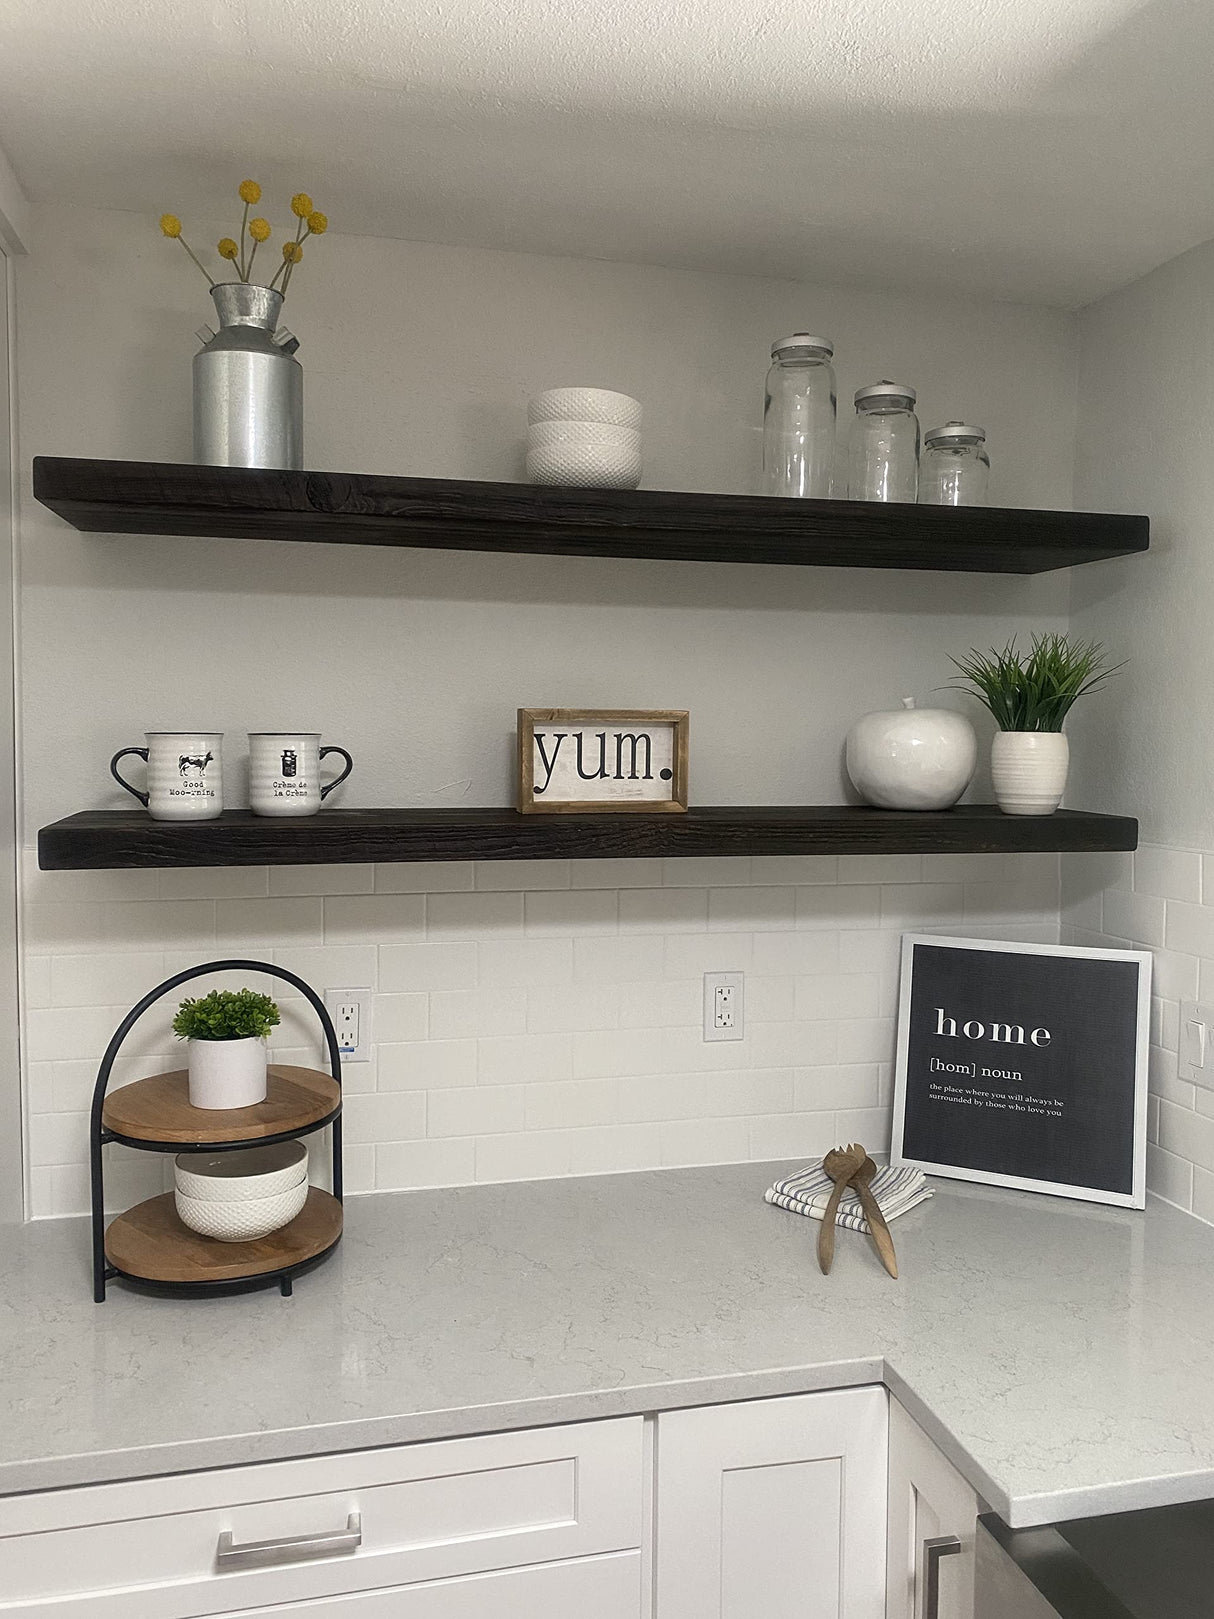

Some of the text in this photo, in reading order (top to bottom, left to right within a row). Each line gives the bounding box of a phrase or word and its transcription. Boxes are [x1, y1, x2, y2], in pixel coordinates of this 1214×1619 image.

[533, 731, 673, 794] yum.
[183, 780, 204, 788] Good
[932, 1007, 1051, 1047] home
[930, 1057, 1023, 1081] [hom] noun
[929, 1083, 1064, 1107] the place where you will always be
[929, 1093, 1062, 1117] surrounded by those who love you
